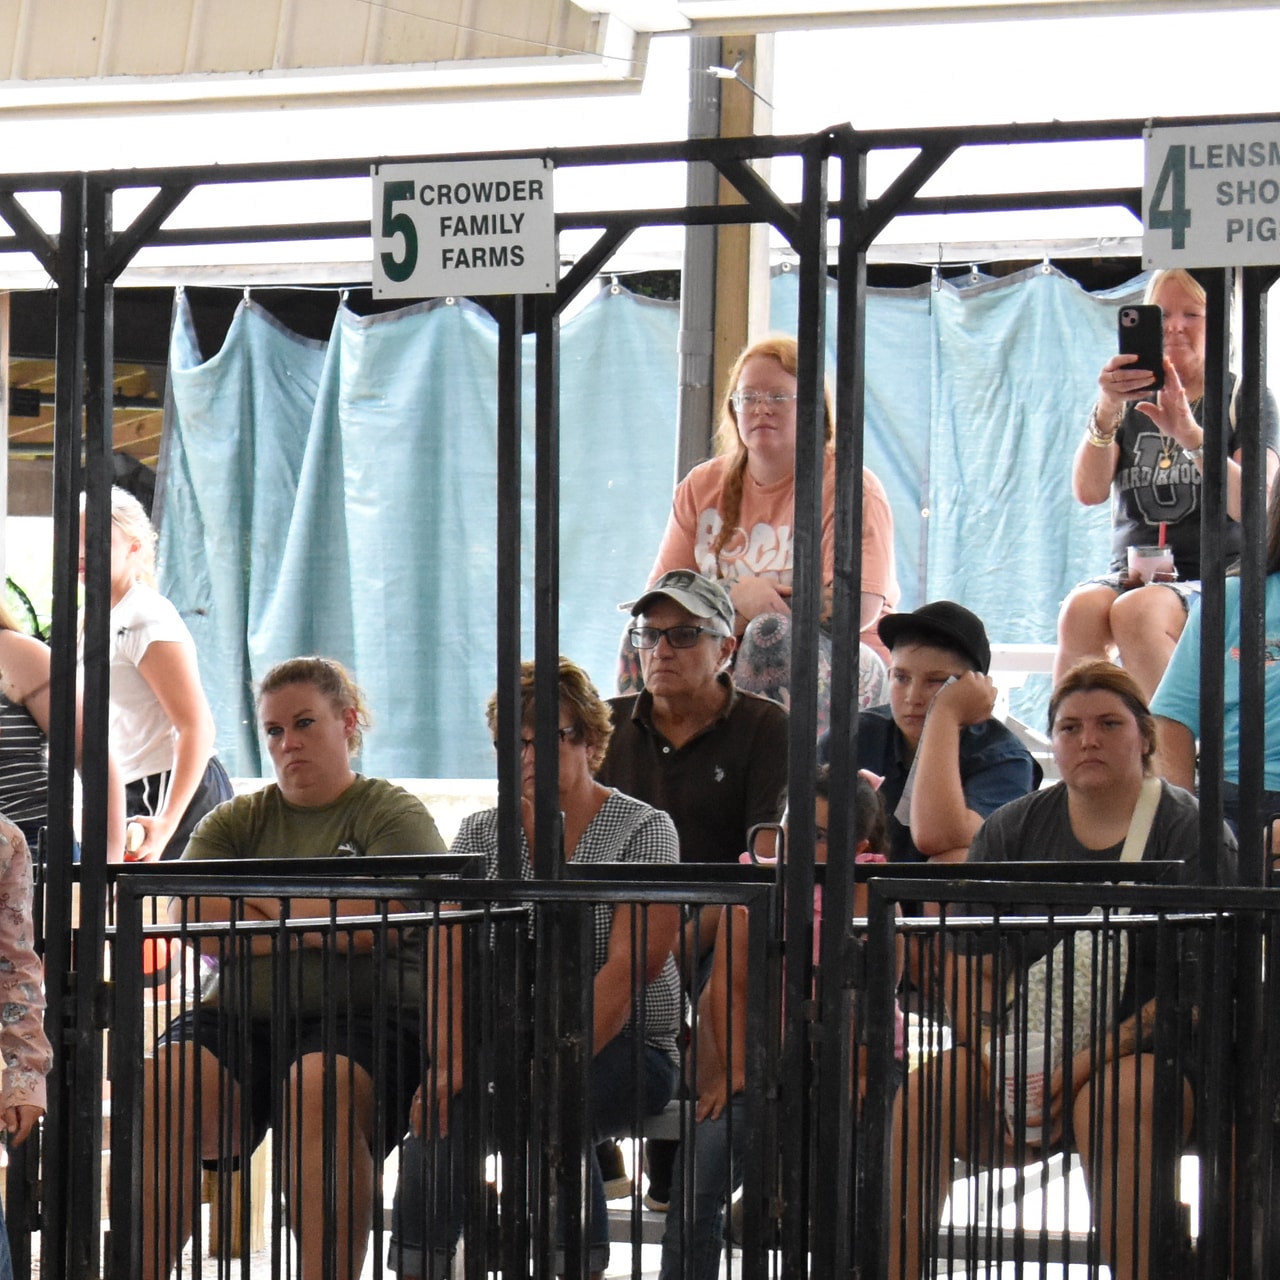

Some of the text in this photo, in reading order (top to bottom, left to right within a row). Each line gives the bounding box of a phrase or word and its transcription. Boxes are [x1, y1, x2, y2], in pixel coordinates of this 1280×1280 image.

[419, 179, 544, 206] CROWDER
[1148, 144, 1191, 250] 4
[1216, 179, 1280, 206] SHO
[380, 180, 418, 282] 5
[440, 212, 525, 237] FAMILY
[1226, 216, 1280, 243] PIG
[441, 245, 525, 269] FARMS
